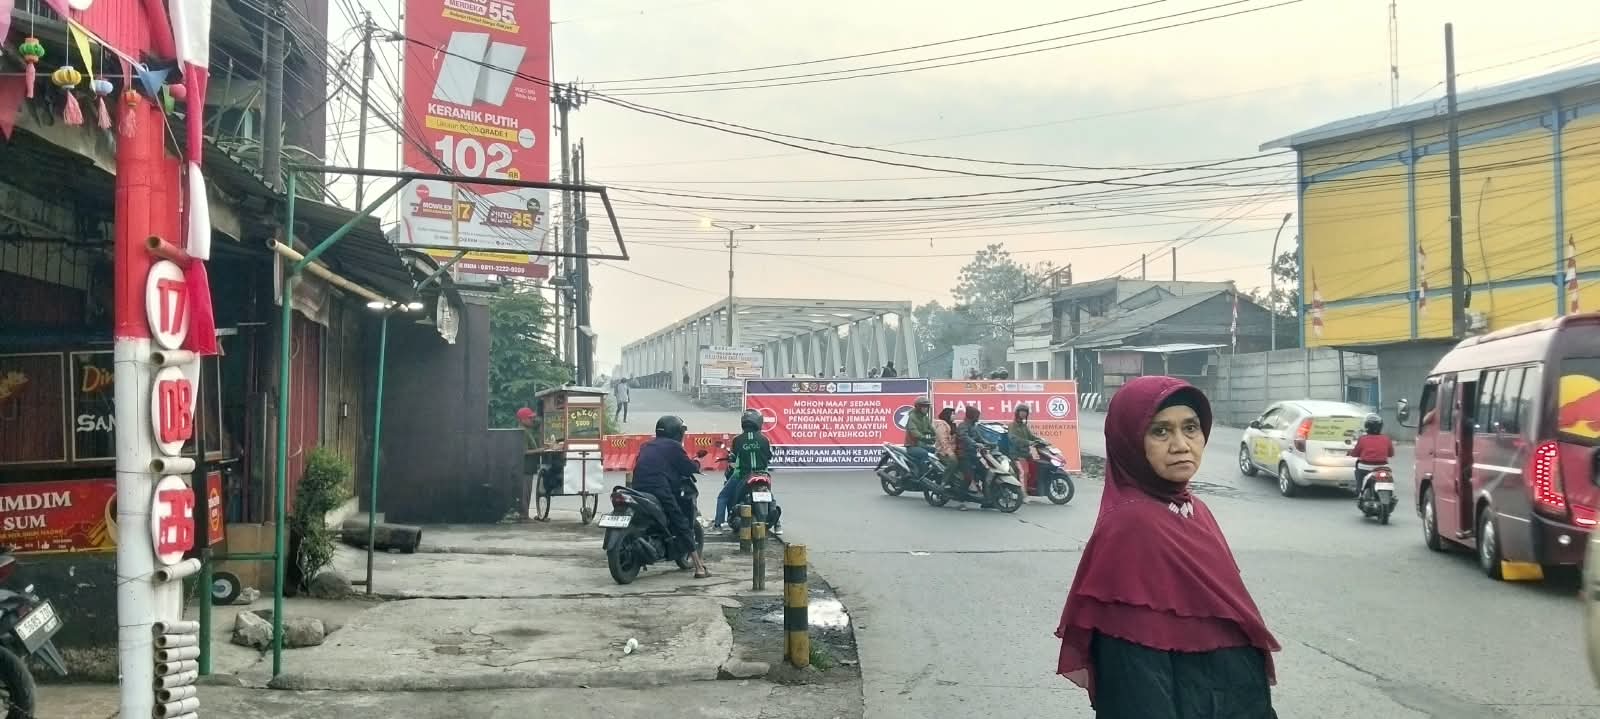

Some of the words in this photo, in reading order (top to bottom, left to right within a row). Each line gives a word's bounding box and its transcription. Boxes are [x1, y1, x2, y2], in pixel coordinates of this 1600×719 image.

[489, 1, 516, 24] 55
[428, 103, 482, 122] KERAMIK
[484, 113, 518, 128] PUTIH
[435, 134, 512, 179] 102
[512, 211, 531, 227] 45
[156, 278, 188, 336] 17
[159, 379, 192, 444] 08
[1052, 403, 1065, 412] 20
[788, 415, 844, 423] PENGGANTIAN
[819, 431, 882, 439] (DAYEUHKOLOT)
[3, 514, 47, 531] SUM
